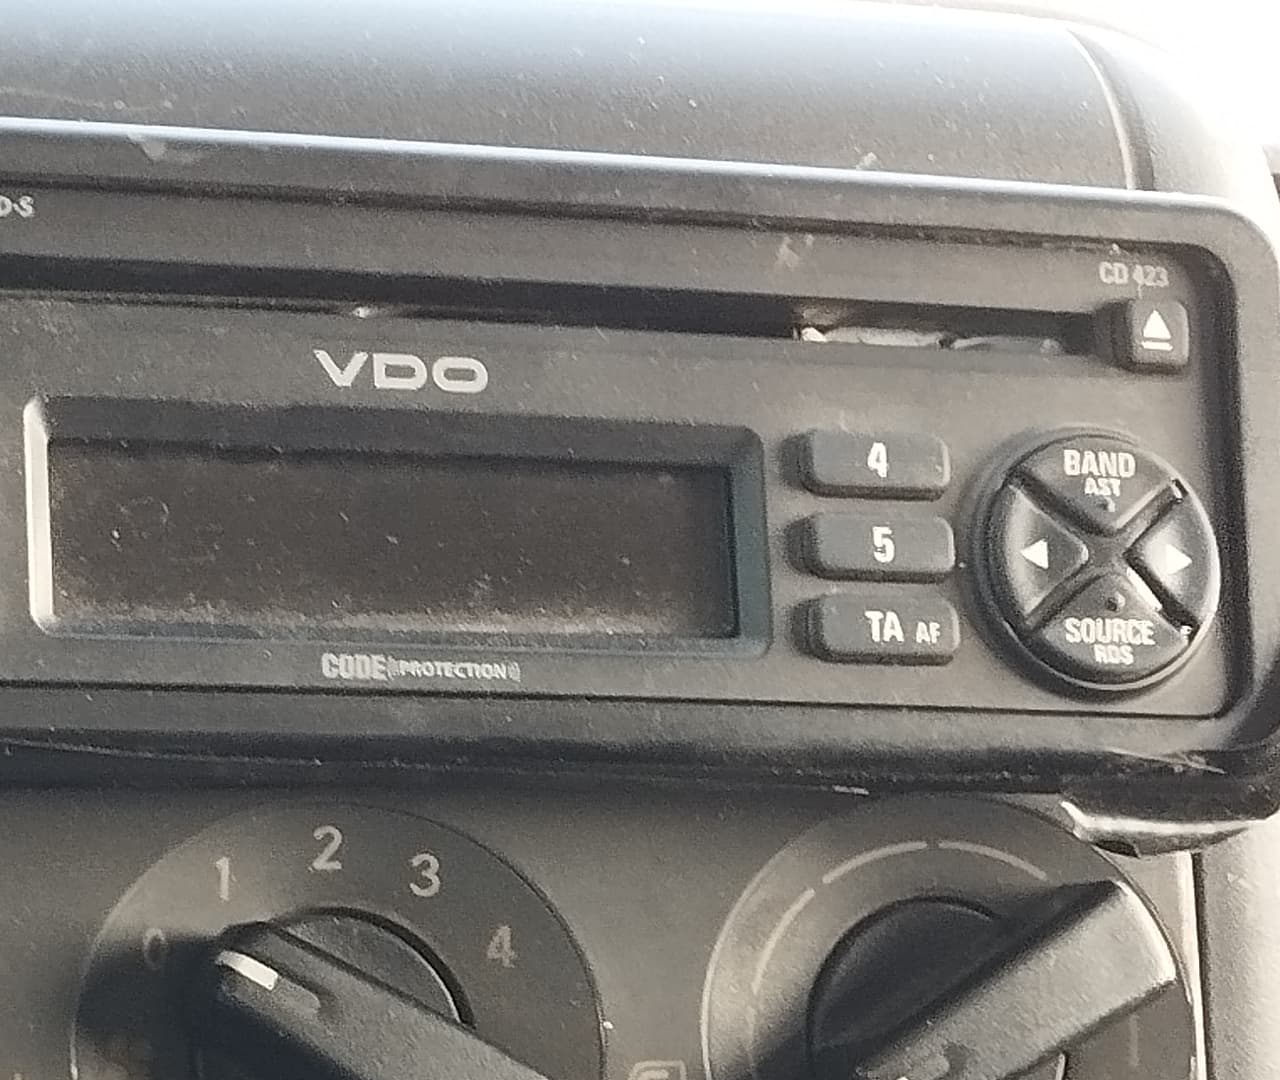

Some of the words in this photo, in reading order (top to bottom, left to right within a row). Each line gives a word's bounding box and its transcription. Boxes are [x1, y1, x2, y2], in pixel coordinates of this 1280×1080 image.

[1099, 260, 1128, 284] CD
[313, 349, 489, 393] VDO
[866, 441, 889, 478] 4
[1063, 449, 1136, 477] BAND
[1084, 477, 1123, 498] AST
[872, 526, 896, 563] 5
[865, 610, 904, 643] TA
[915, 620, 941, 644] AF
[1064, 617, 1156, 647] SOURCE
[321, 653, 387, 681] CODE
[398, 660, 507, 680] PROTECTION
[1093, 643, 1135, 666] RDS
[215, 856, 232, 901] 1
[313, 826, 343, 872] 2
[408, 853, 441, 897] 3
[487, 925, 516, 968] 4
